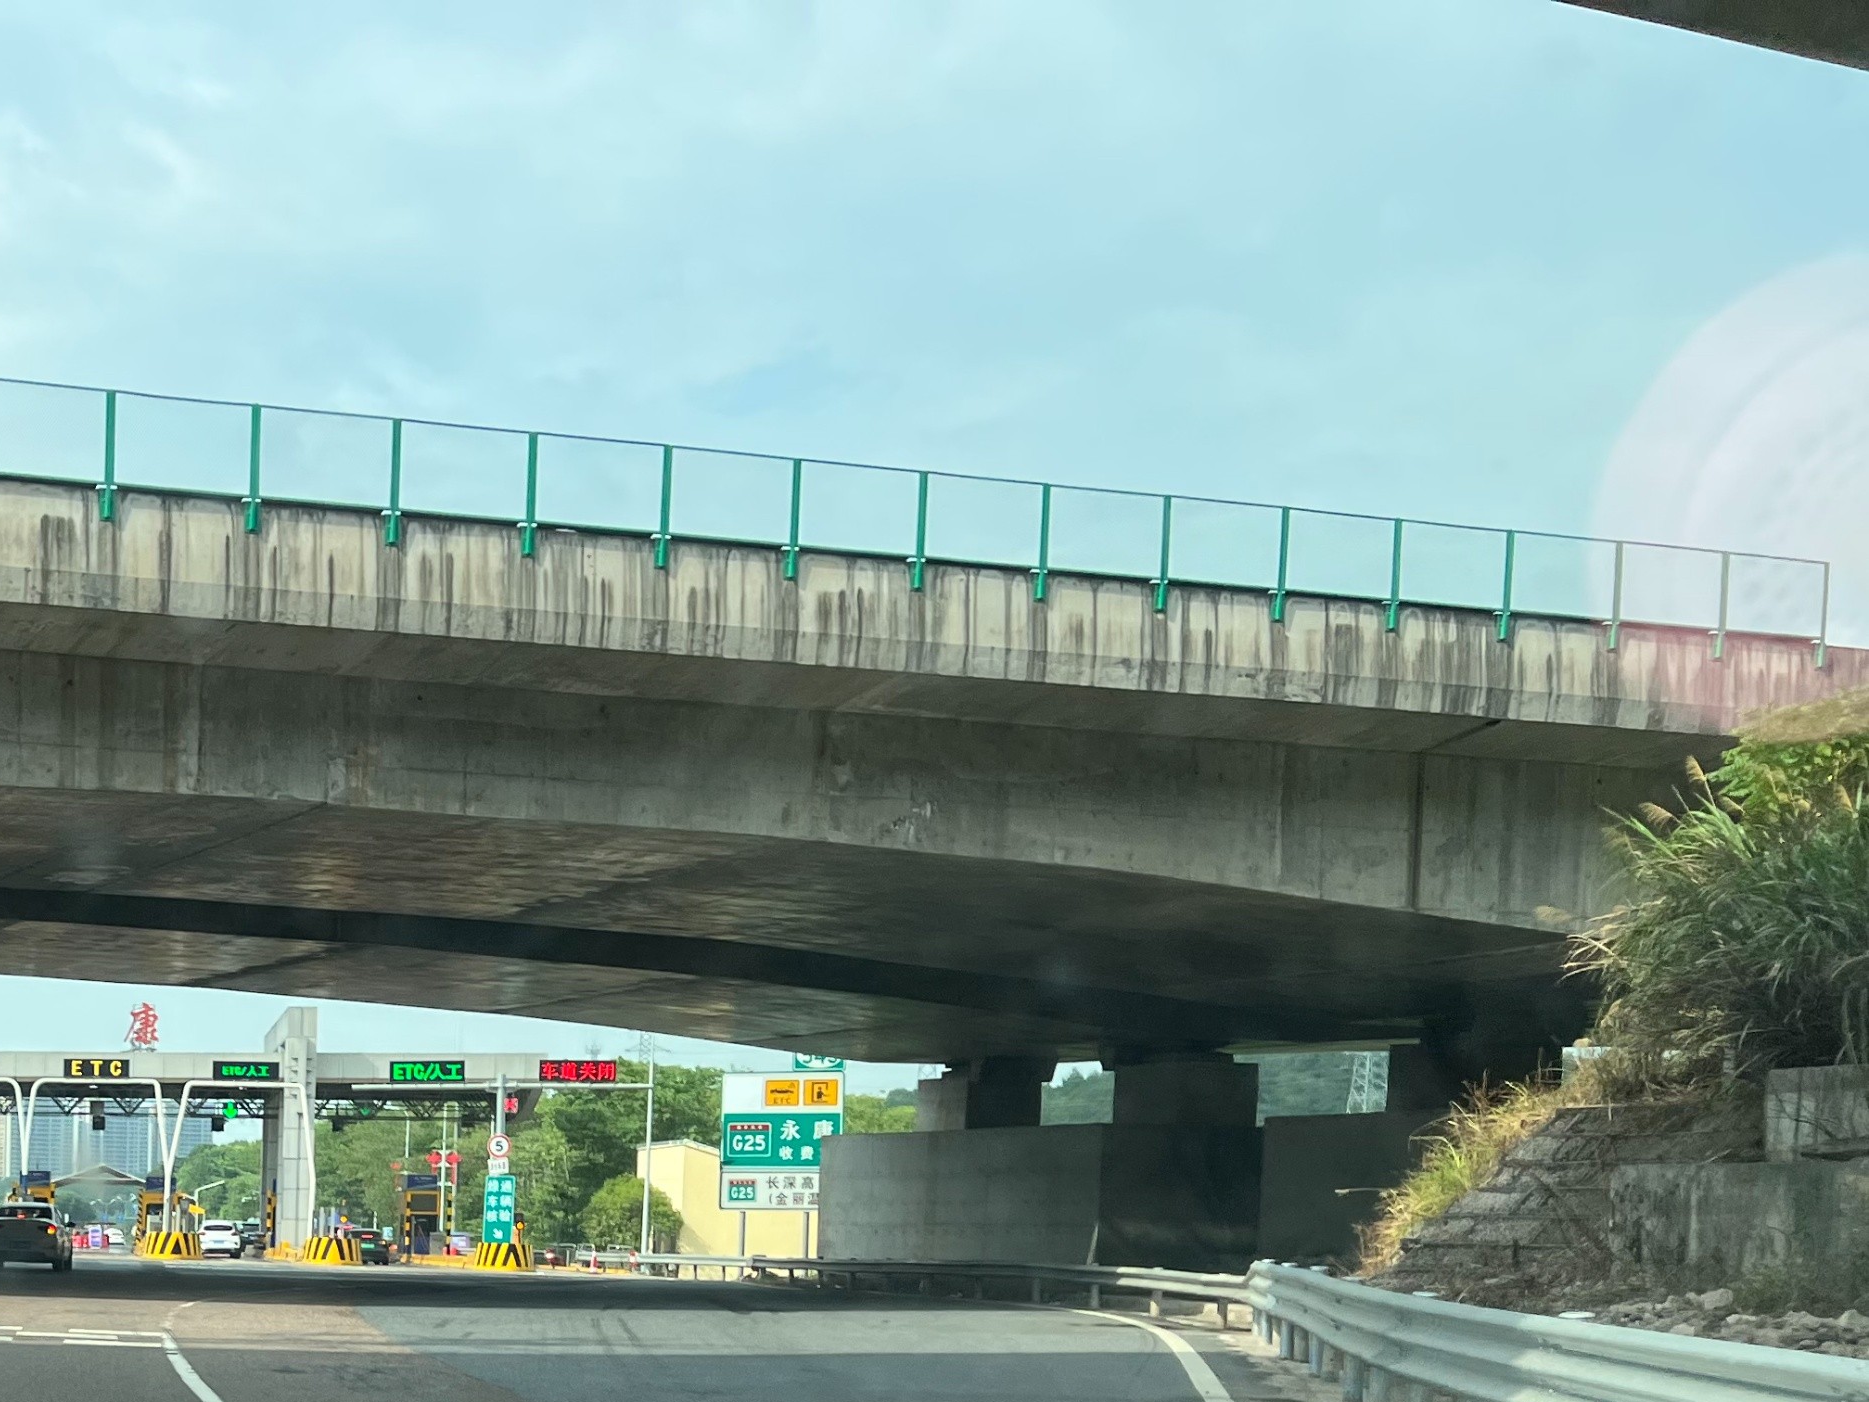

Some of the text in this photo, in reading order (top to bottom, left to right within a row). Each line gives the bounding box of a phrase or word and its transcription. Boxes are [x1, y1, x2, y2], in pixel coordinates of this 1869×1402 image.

[71, 1059, 122, 1077] ETC
[392, 1062, 463, 1081] ETC/人工
[541, 1061, 616, 1081] 车道关闭
[780, 1119, 834, 1140] 永康
[495, 1140, 504, 1152] 5
[732, 1134, 766, 1151] G25
[730, 1187, 754, 1199] G25
